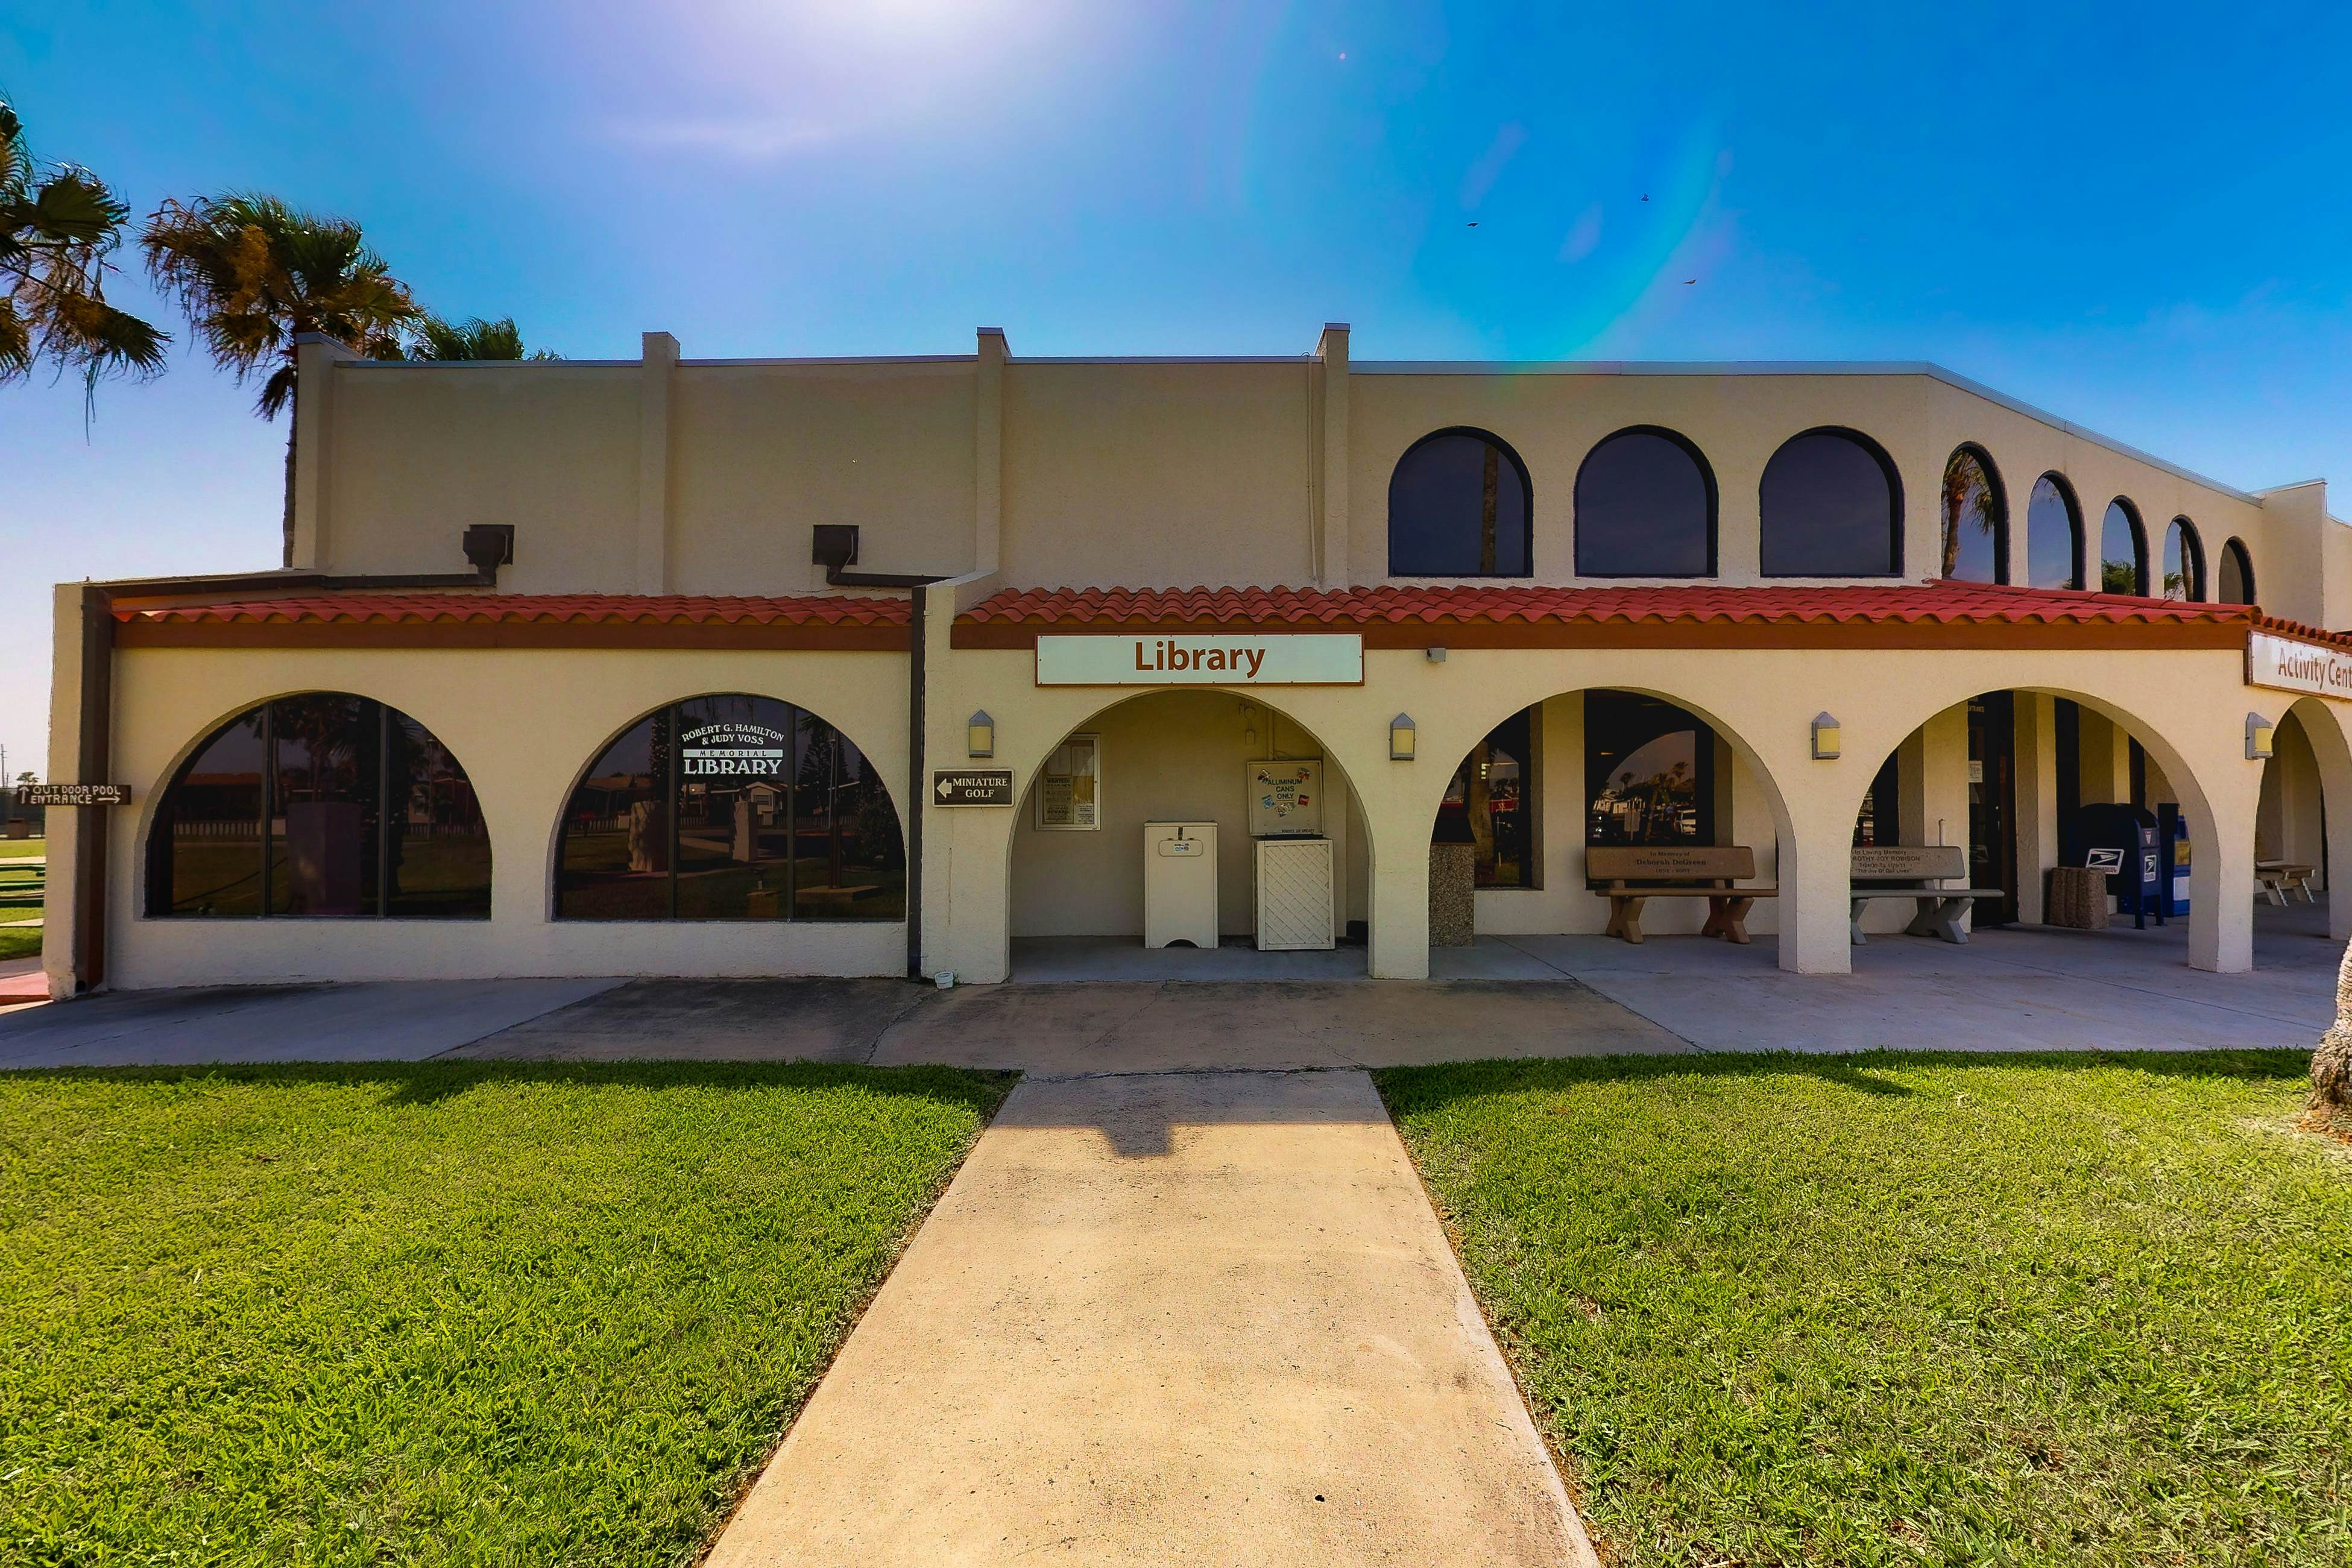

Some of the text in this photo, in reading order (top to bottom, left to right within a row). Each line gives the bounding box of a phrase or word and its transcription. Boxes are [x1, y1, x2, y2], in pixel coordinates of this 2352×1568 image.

[1135, 640, 1266, 679] Library
[2278, 647, 2325, 690] Activity
[681, 723, 784, 742] ROBERT G. HAMILTON
[702, 734, 765, 746] & JUDY VOSS
[684, 758, 783, 775] LIBRARY
[953, 778, 1008, 787] MINIATURE
[92, 786, 121, 795] POOL
[965, 789, 995, 798] GOLF
[31, 794, 92, 804] ENTRANCE
